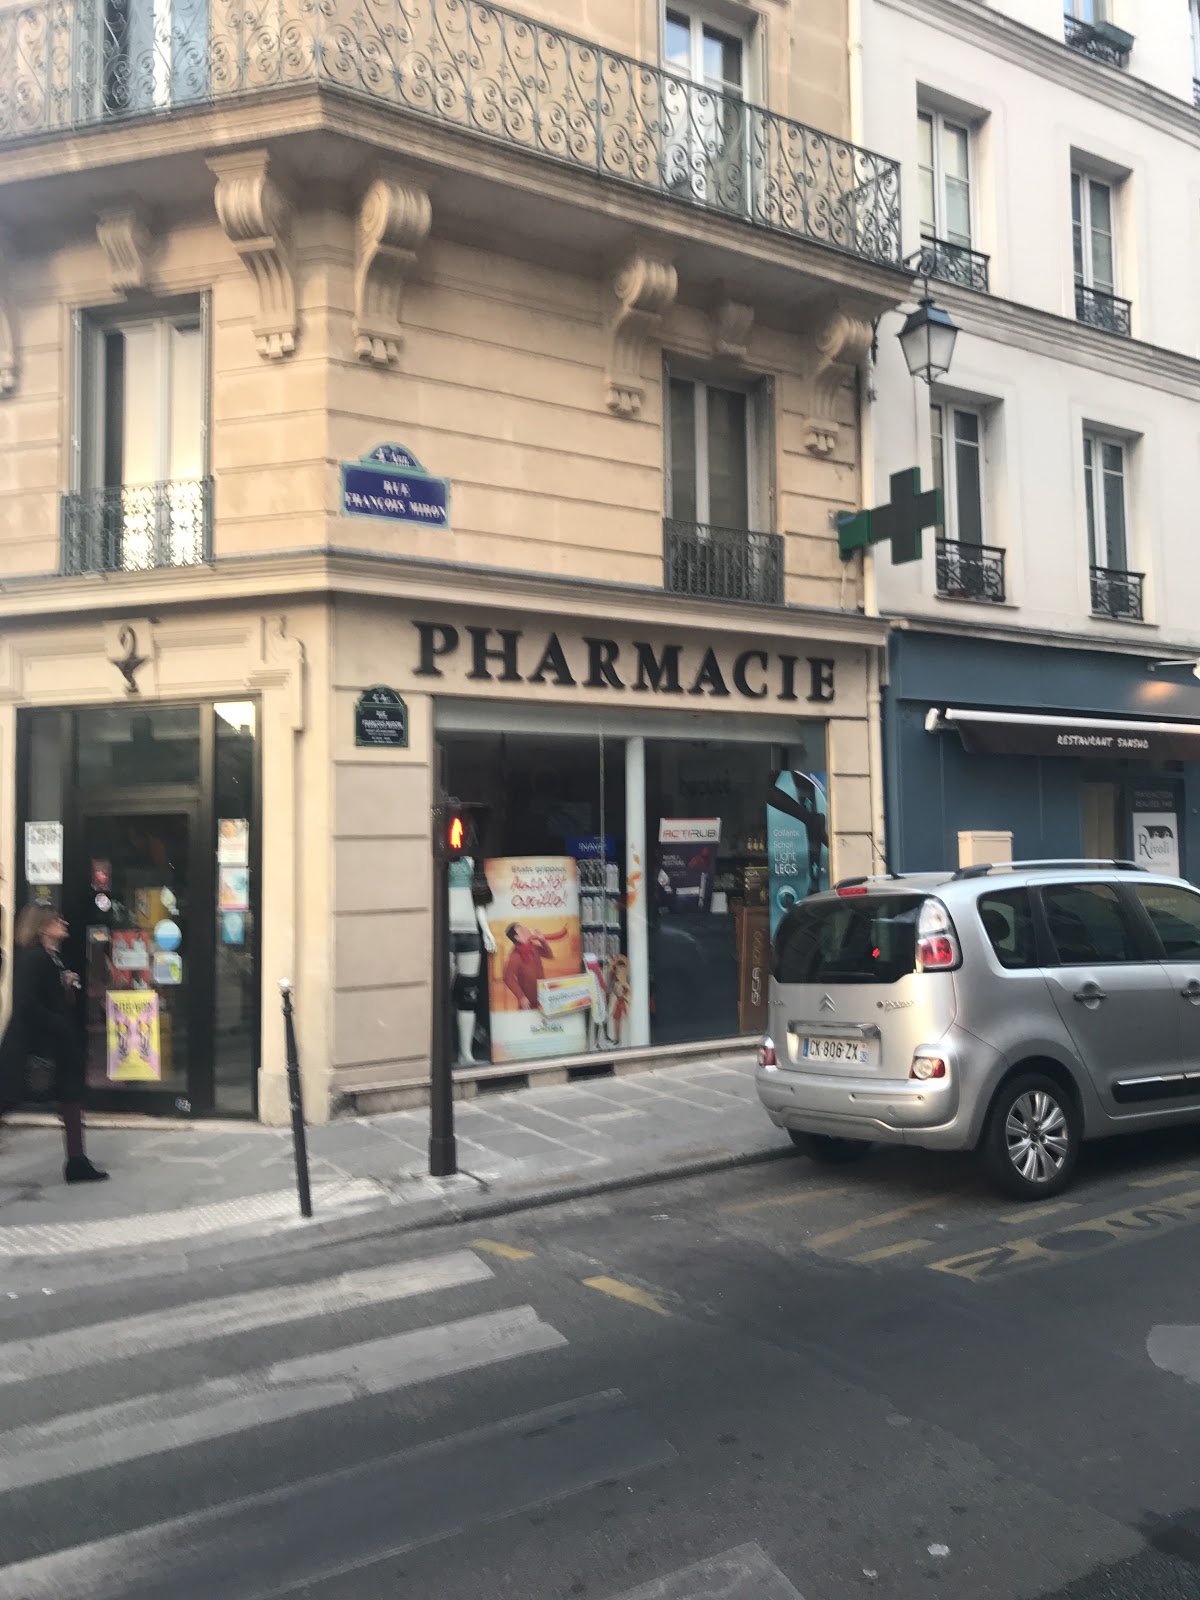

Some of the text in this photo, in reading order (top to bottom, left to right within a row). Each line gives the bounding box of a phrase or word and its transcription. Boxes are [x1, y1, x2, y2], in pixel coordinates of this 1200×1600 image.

[383, 479, 412, 498] RUE
[409, 500, 447, 520] MIRON
[412, 620, 836, 702] PHARMACIE
[1057, 734, 1114, 748] RESTAURANT
[662, 829, 717, 839] ACTIRUB
[1138, 834, 1170, 860] Rivoli
[774, 852, 797, 864] Light
[774, 863, 799, 876] LEGS
